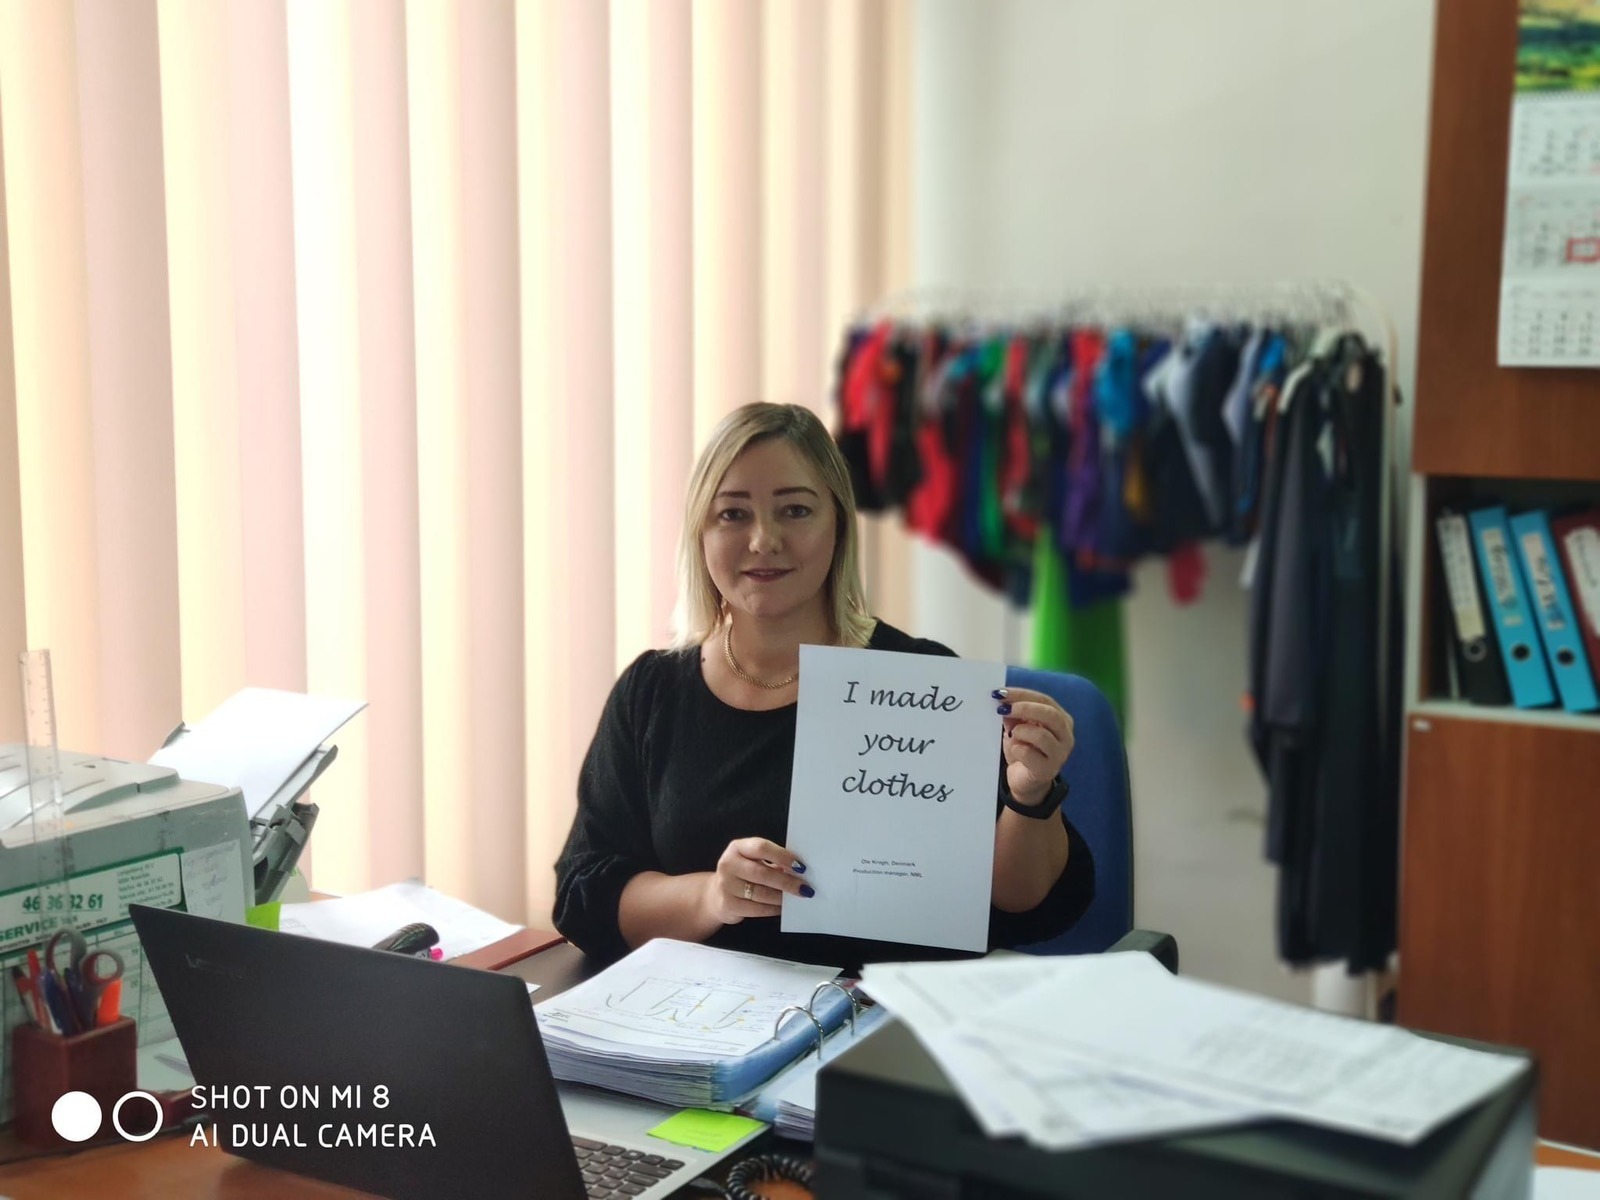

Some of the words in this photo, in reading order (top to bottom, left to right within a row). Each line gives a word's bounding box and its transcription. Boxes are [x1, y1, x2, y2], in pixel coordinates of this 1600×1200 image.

[843, 681, 859, 703] I
[870, 686, 963, 712] made
[858, 733, 935, 756] your
[842, 769, 954, 802] clothes
[23, 895, 40, 912] 46
[46, 894, 63, 911] 36
[88, 893, 103, 910] 61
